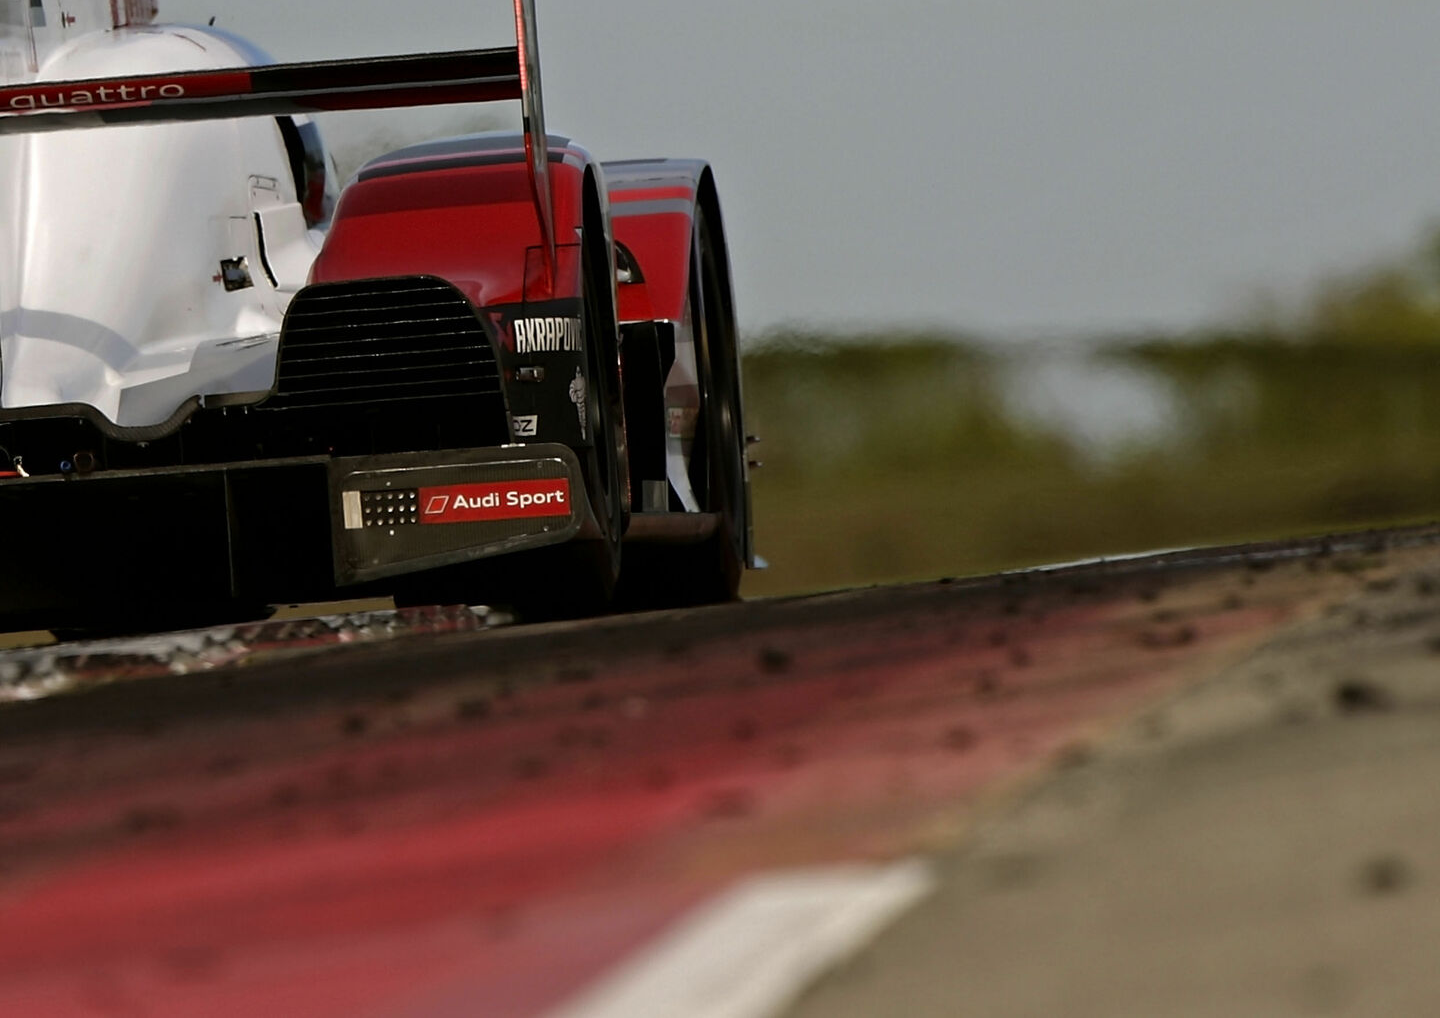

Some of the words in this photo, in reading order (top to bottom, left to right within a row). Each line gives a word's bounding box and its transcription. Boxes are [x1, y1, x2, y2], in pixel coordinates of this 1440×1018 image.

[10, 83, 185, 110] quattro
[453, 492, 500, 509] Audi
[506, 490, 565, 508] Sport
